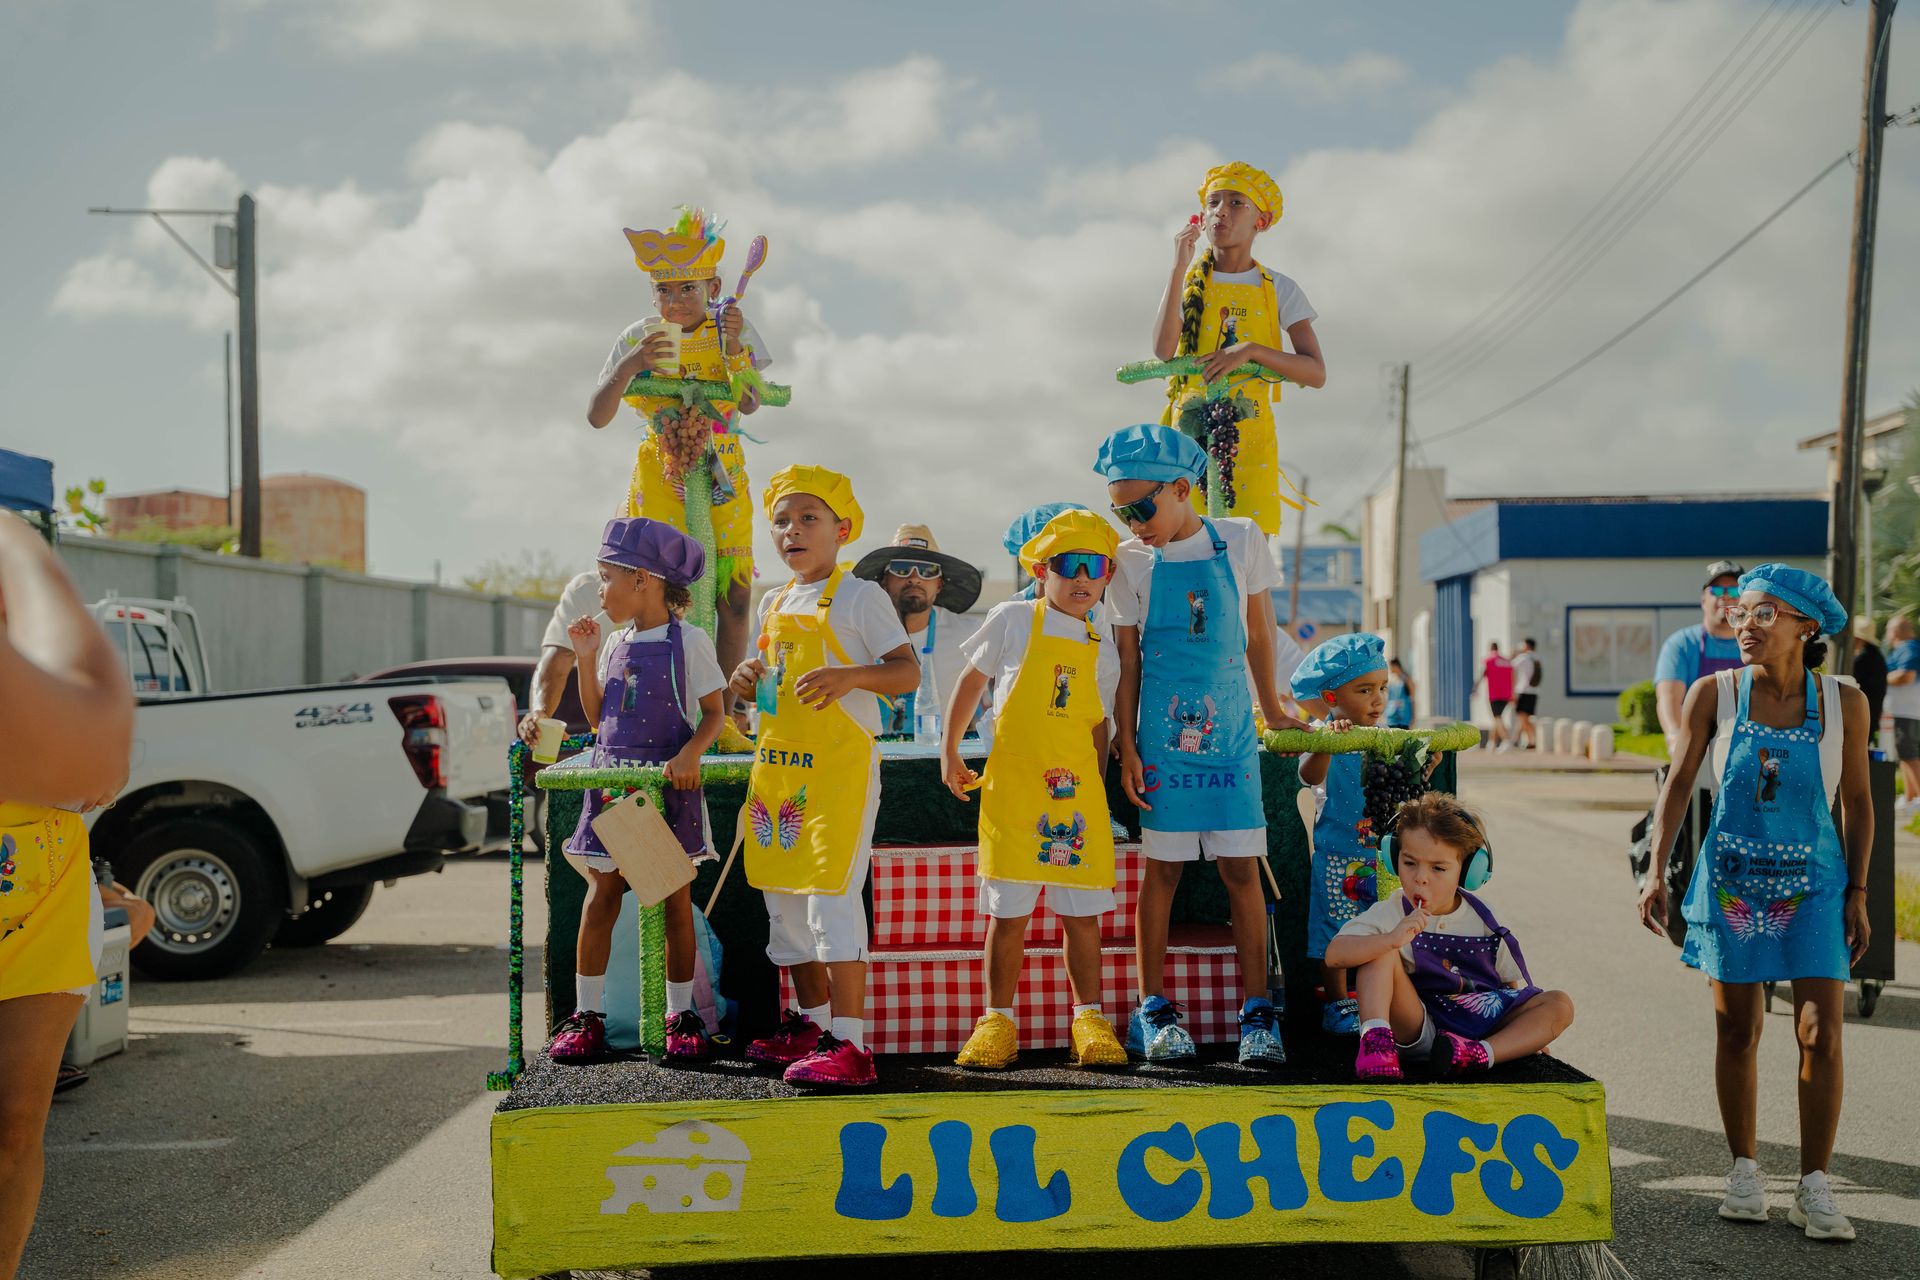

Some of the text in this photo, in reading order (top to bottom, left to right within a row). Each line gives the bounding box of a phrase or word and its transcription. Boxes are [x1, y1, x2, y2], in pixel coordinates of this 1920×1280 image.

[1231, 307, 1247, 317] TOB
[1195, 589, 1209, 598] TOB
[781, 641, 794, 650] TOB
[1063, 665, 1077, 676] TOB
[760, 747, 814, 769] SETAR
[1770, 748, 1790, 759] TOB
[1168, 772, 1237, 789] SETAR
[1749, 857, 1807, 868] NEW INDIA
[1747, 867, 1807, 876] ASSURANCE
[836, 1099, 1579, 1222] LIL CHEFS
